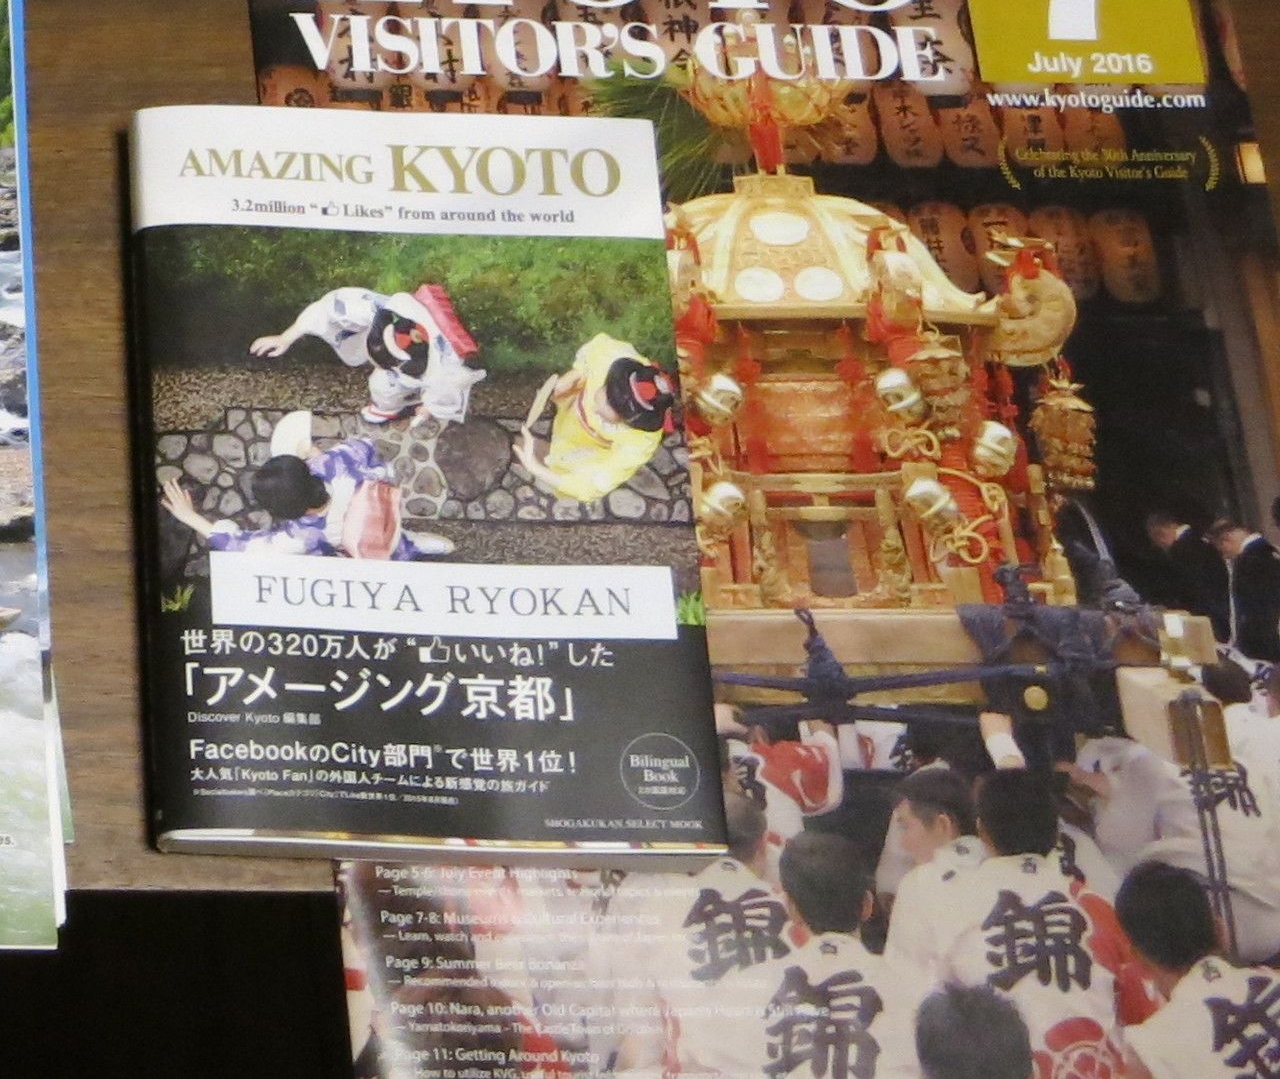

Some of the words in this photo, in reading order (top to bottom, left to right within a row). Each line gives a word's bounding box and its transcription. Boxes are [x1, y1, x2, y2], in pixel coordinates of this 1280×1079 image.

[290, 12, 667, 77] VISITOR'S
[696, 21, 946, 81] GUIDE
[1027, 51, 1082, 76] July
[1090, 53, 1154, 74] 2016
[987, 89, 1206, 113] www.kyotoguide.com
[178, 147, 374, 184] AMAZING
[386, 144, 623, 197] KYOTO
[232, 199, 305, 216] 3.2million
[398, 206, 436, 220] from
[441, 208, 497, 222] around
[502, 208, 525, 223] the
[529, 208, 575, 224] world
[253, 574, 424, 613] FUGIYA
[446, 584, 631, 616] RYOKAN
[184, 662, 576, 722] 「アメージング京都」
[187, 711, 240, 725] Discover
[244, 713, 280, 726] Kyoto
[629, 754, 689, 770] Bilingual
[643, 769, 679, 783] Book
[683, 888, 792, 982] 錦
[981, 889, 1092, 993] 錦
[457, 1049, 505, 1064] Getting
[508, 1049, 556, 1062] Around
[561, 1050, 599, 1064] Kyoto
